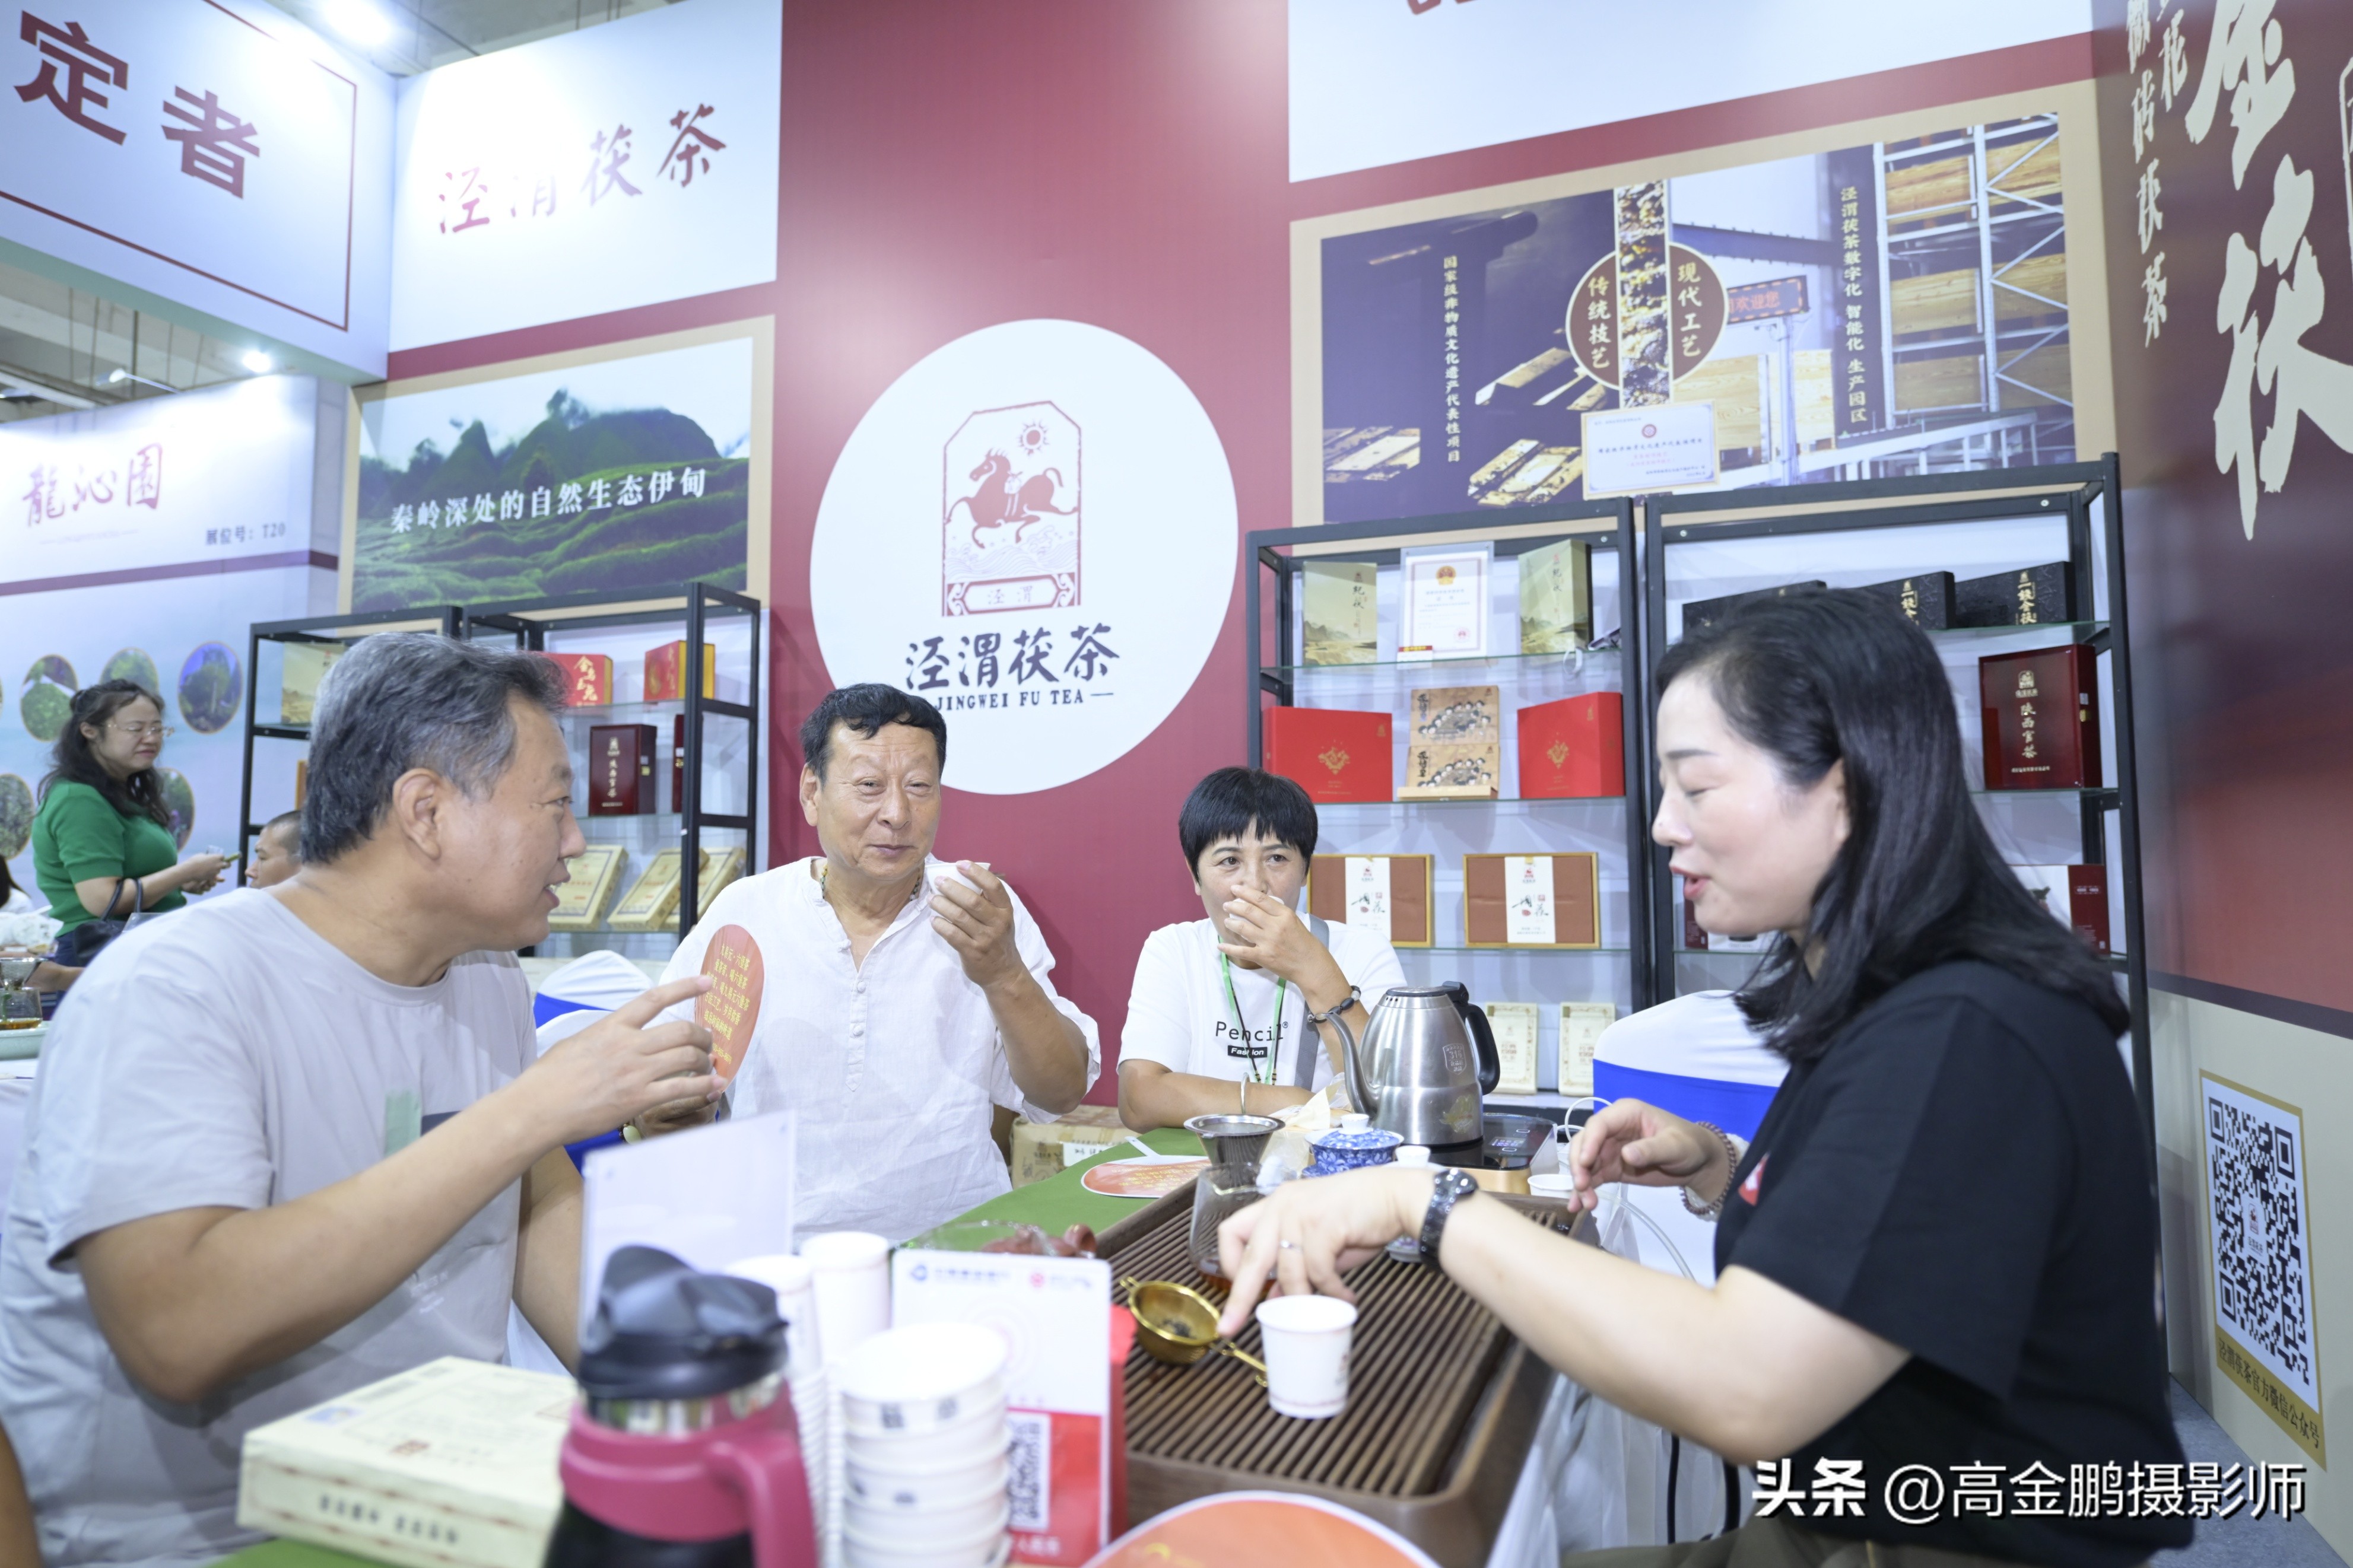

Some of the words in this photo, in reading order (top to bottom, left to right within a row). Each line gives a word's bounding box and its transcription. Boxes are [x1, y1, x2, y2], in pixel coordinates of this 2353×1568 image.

[14, 10, 260, 199] 定者
[1587, 275, 1612, 370] 传统技艺
[1676, 262, 1703, 358] 现代工艺
[1845, 304, 1865, 352] 智能化
[1443, 255, 1460, 463] 国家级非物质文化遗产代表性项目
[1846, 358, 1868, 424] 生产园区
[390, 467, 706, 534] 秦岭深处的自然生态伊甸
[987, 586, 1033, 605] 泾渭
[905, 622, 1120, 691] 泾渭茯茶
[935, 692, 1009, 711] JINGWEI
[1020, 691, 1041, 707] FU
[1050, 688, 1084, 704] TEA
[2218, 1336, 2320, 1449] 泾渭茯茶官方微信公众号
